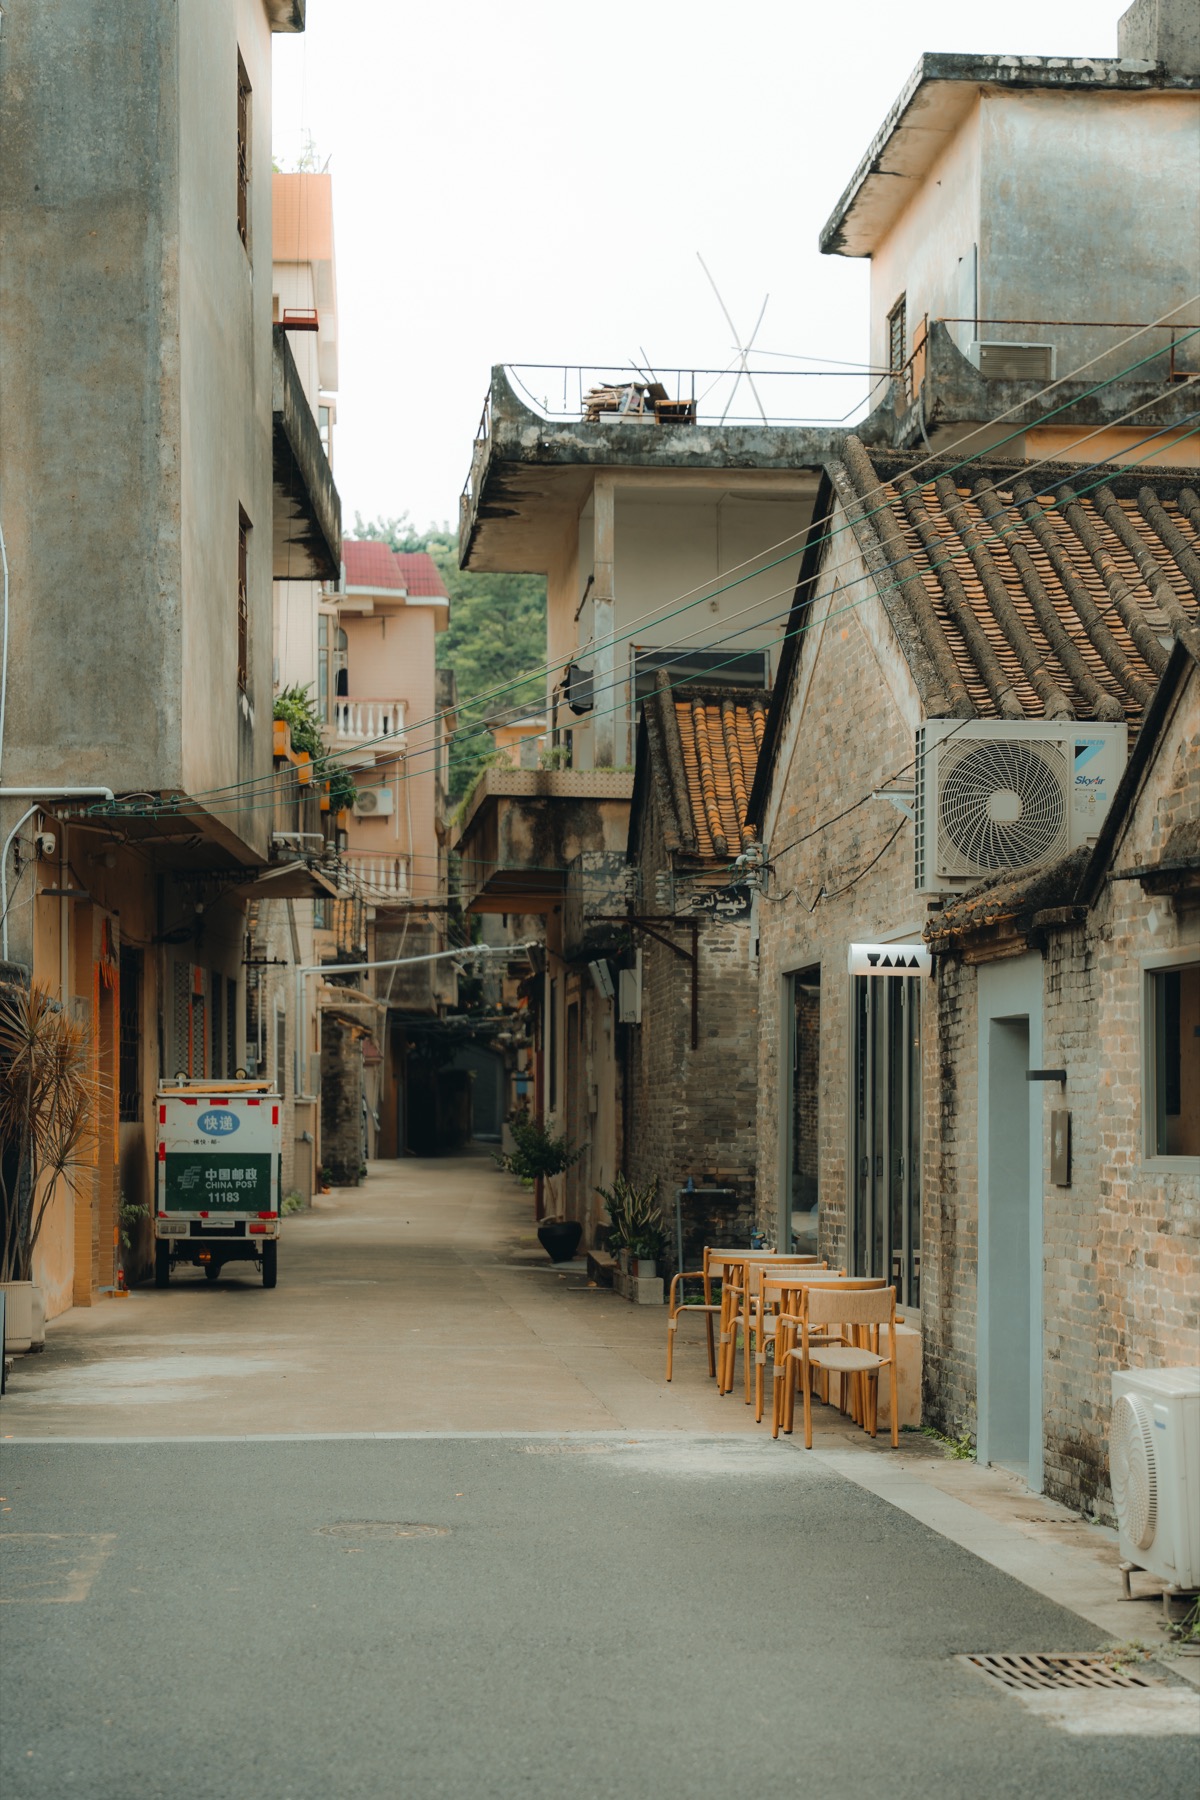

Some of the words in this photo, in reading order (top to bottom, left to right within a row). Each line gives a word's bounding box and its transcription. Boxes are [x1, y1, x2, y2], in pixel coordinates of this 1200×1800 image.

[204, 1115, 233, 1131] 快递
[205, 1168, 257, 1181] 中国邮政
[205, 1181, 233, 1189] CHINA
[208, 1191, 240, 1203] 11183
